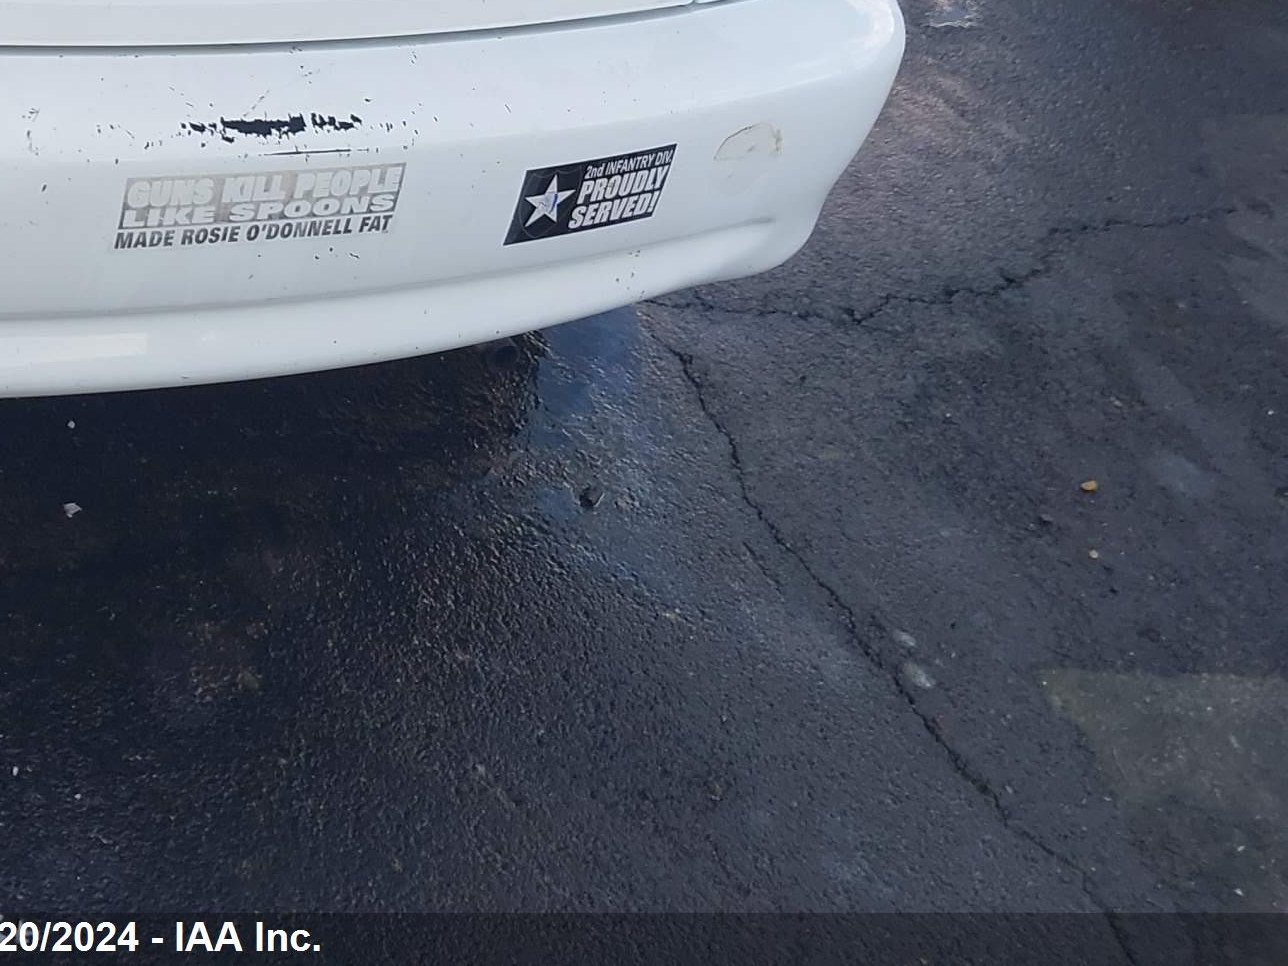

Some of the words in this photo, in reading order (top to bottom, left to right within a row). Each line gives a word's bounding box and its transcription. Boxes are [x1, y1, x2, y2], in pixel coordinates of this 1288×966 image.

[584, 165, 605, 180] 2nd
[605, 154, 654, 175] INFANTRY
[654, 149, 673, 166] DIV.
[127, 178, 212, 208] GUNS
[222, 174, 285, 203] KILL
[295, 167, 402, 197] PEOPLE
[576, 165, 669, 205] PROUDLY
[122, 206, 216, 228] LIKE
[229, 194, 394, 221] SPOONS
[568, 191, 661, 229] SERVED!
[114, 230, 174, 249] MADE
[180, 225, 240, 246] ROSIE
[246, 217, 353, 242] O'DONNELL
[359, 214, 393, 233] FAT
